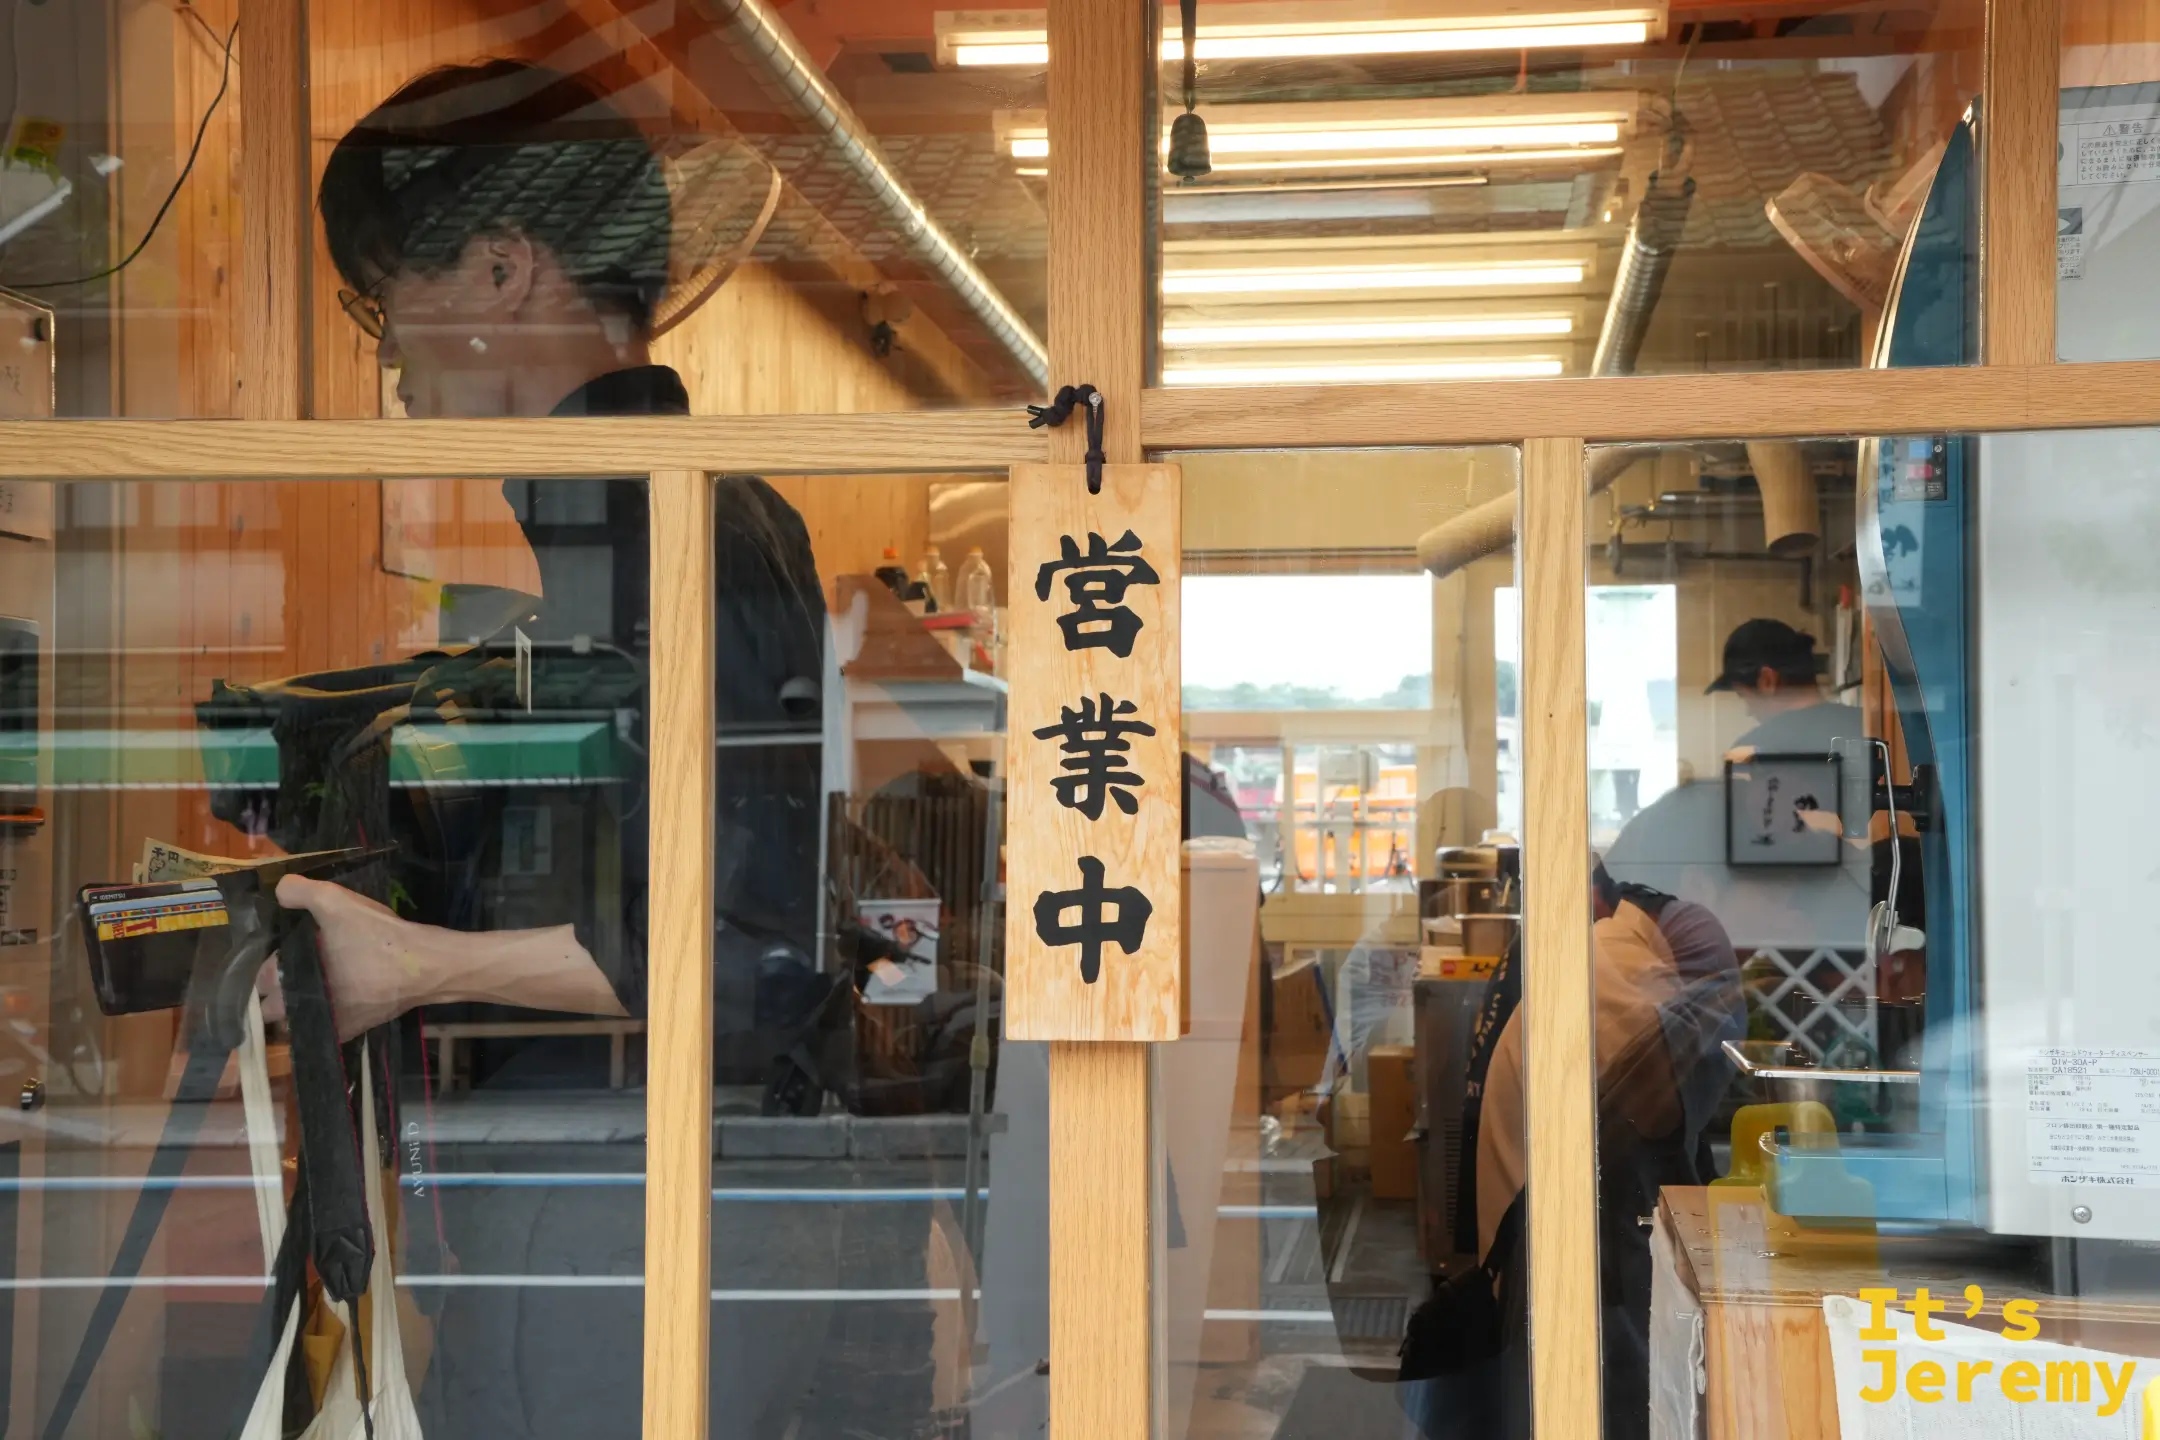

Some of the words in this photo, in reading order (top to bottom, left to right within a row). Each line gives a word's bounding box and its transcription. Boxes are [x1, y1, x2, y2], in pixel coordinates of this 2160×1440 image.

[1032, 530, 1160, 984] 営業中
[2052, 1066, 2088, 1074] CA18521
